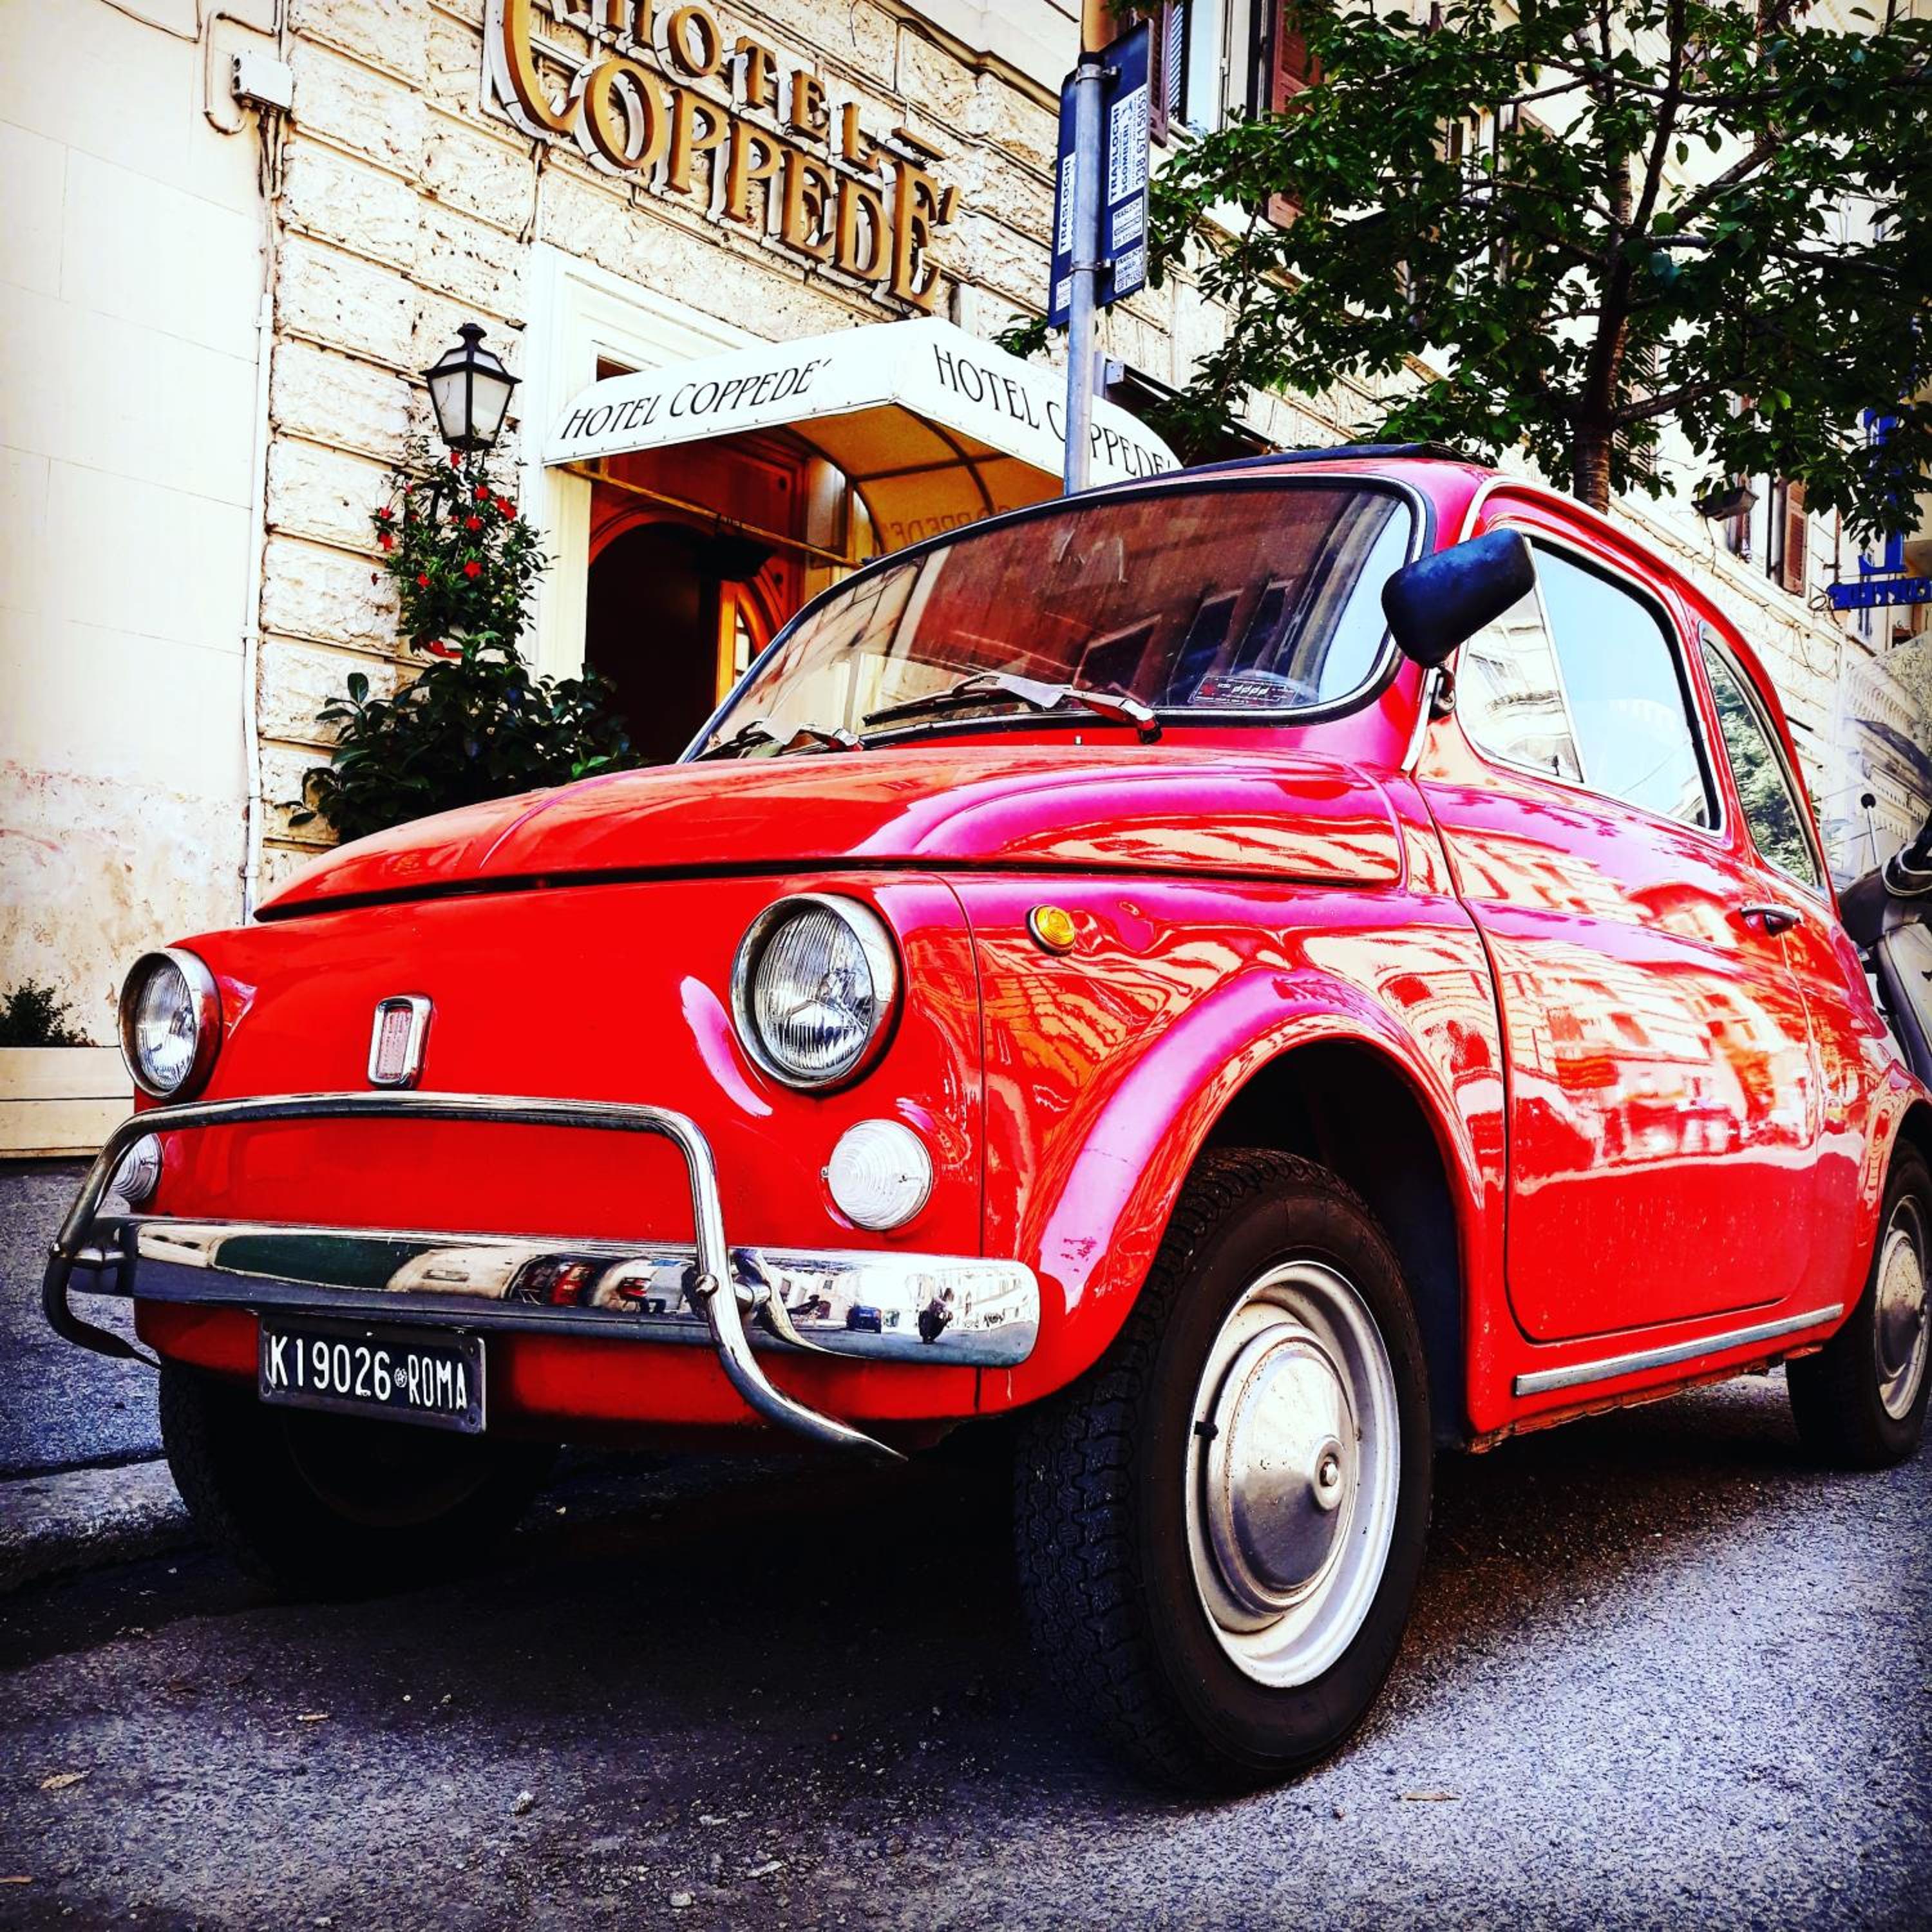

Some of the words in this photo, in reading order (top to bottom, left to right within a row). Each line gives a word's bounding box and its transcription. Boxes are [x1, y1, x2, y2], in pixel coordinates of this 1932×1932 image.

[1110, 107, 1120, 201] TRASLOCHI
[1059, 160, 1070, 249] TRASLOCHI
[560, 393, 662, 440] HOTEL
[933, 343, 1039, 430] HOTEL
[270, 1334, 391, 1401] K19026
[407, 1354, 468, 1410] ROMA
